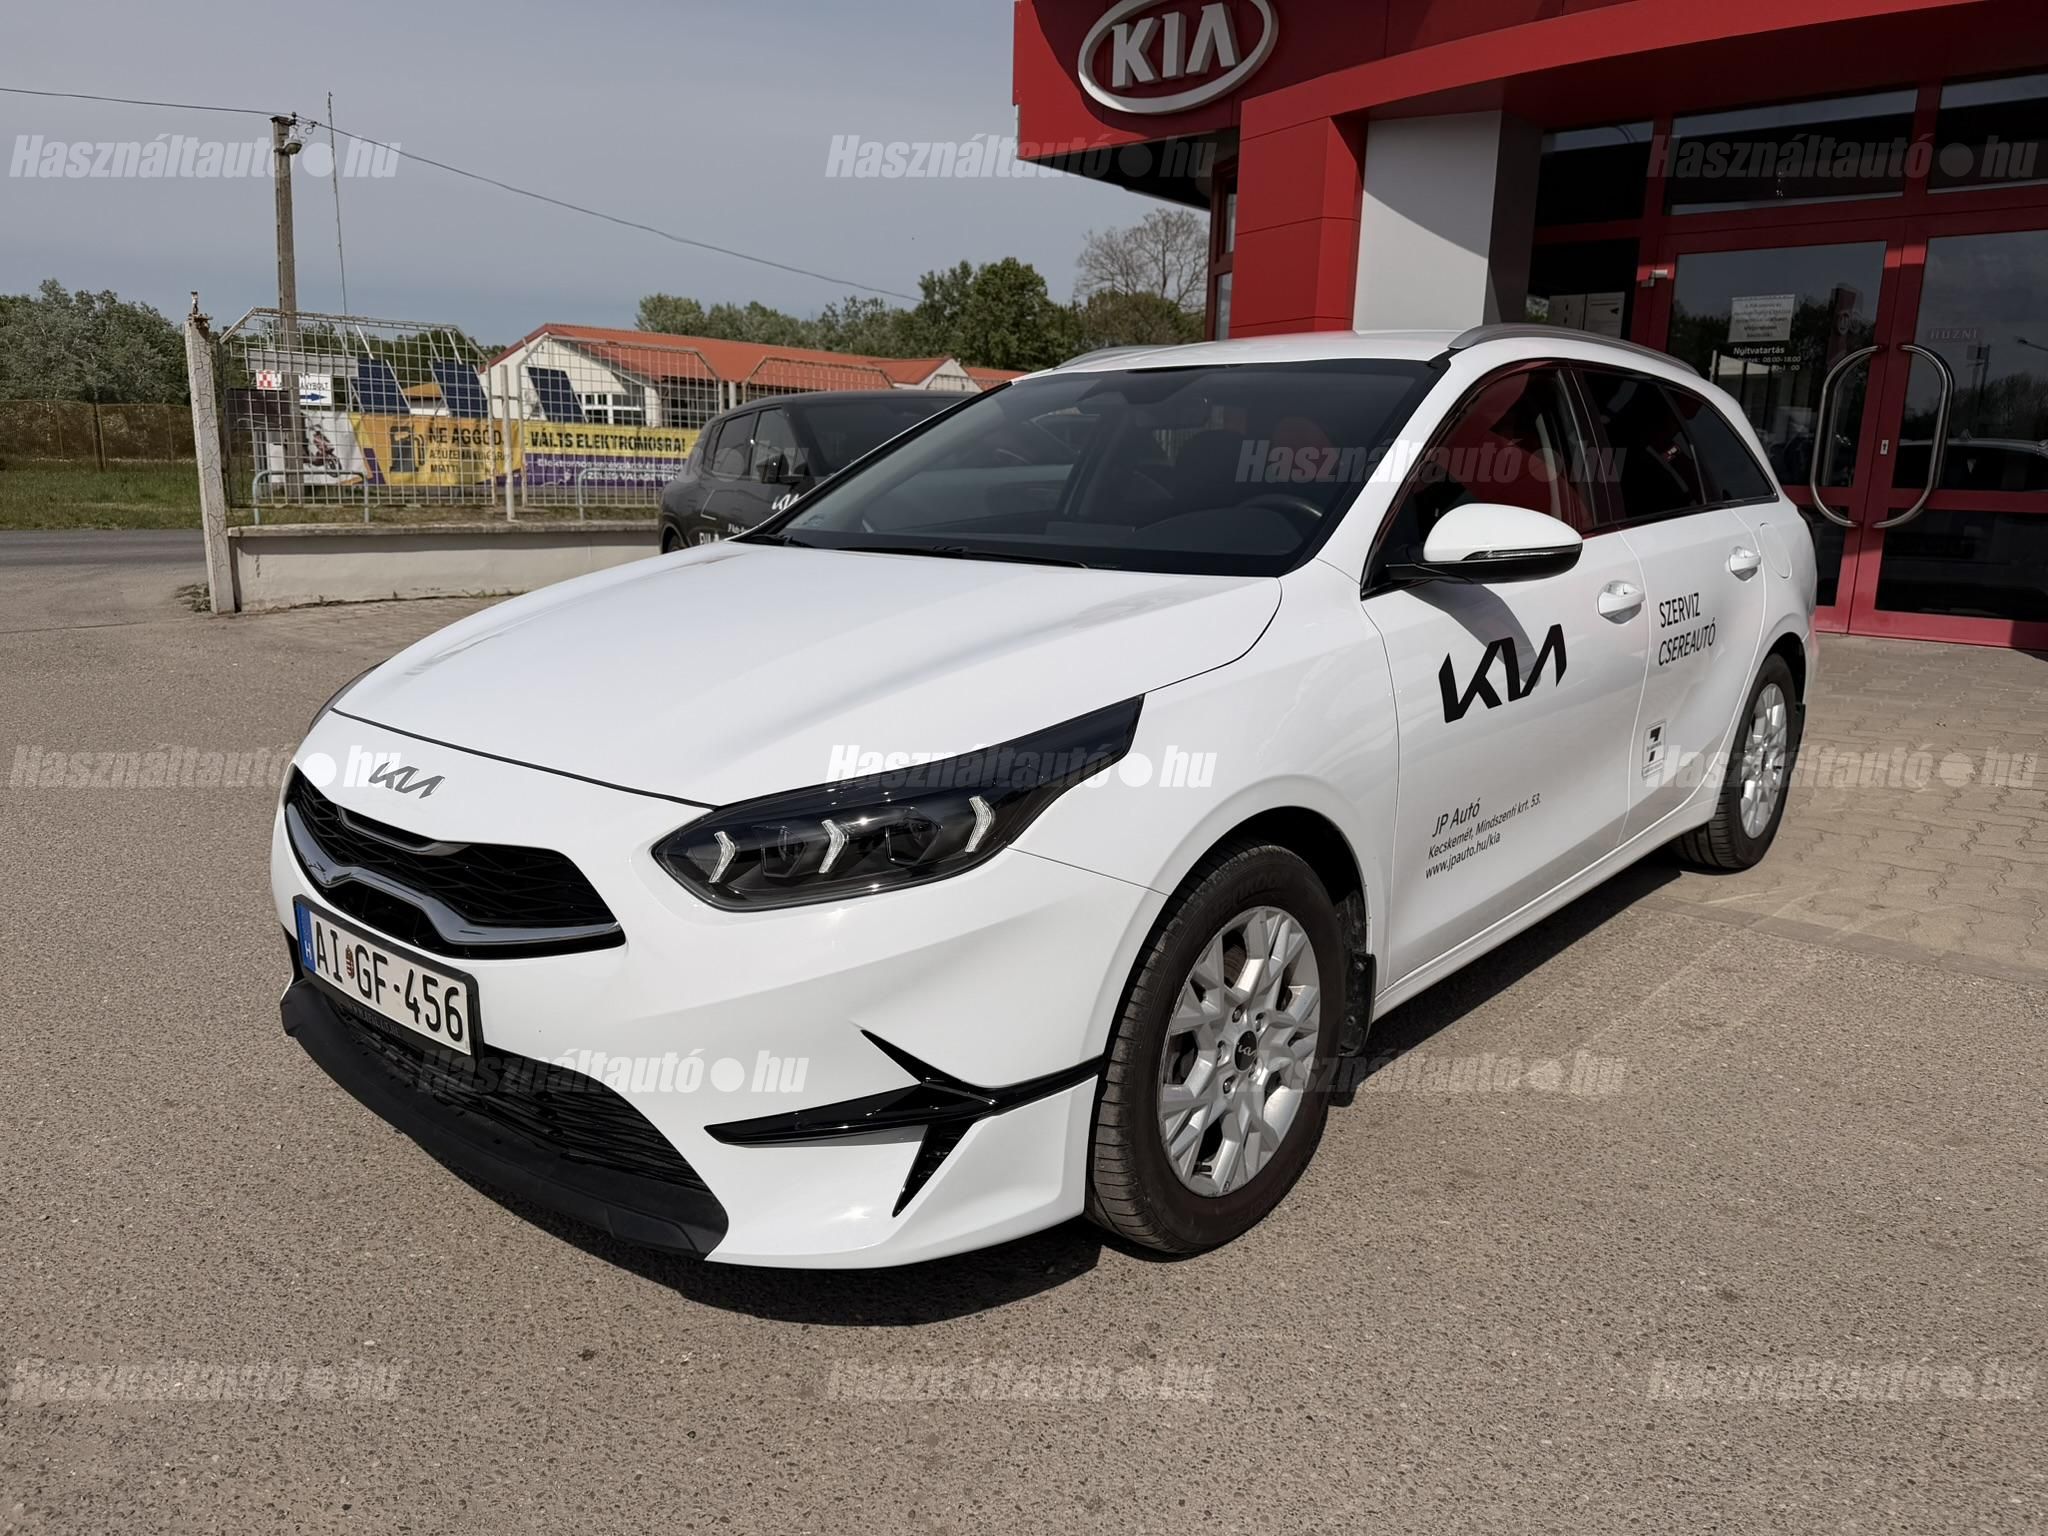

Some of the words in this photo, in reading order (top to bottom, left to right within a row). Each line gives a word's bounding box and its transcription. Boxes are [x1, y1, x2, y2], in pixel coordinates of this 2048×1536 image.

[1112, 2, 1240, 88] KIA
[428, 427, 448, 444] NE
[1659, 592, 1700, 628] SZERVIZ
[1658, 617, 1716, 666] CSEREAUTÓ
[1438, 623, 1567, 723] KIA
[368, 761, 446, 799] KIA
[1432, 813, 1448, 838] JP
[1449, 797, 1481, 829] Autó
[1475, 803, 1517, 836] Mindszenti
[1425, 831, 1501, 879] www.jpauto.hu/kia
[305, 941, 312, 961] H
[315, 921, 343, 984] AI
[355, 944, 463, 1043] GF-456
